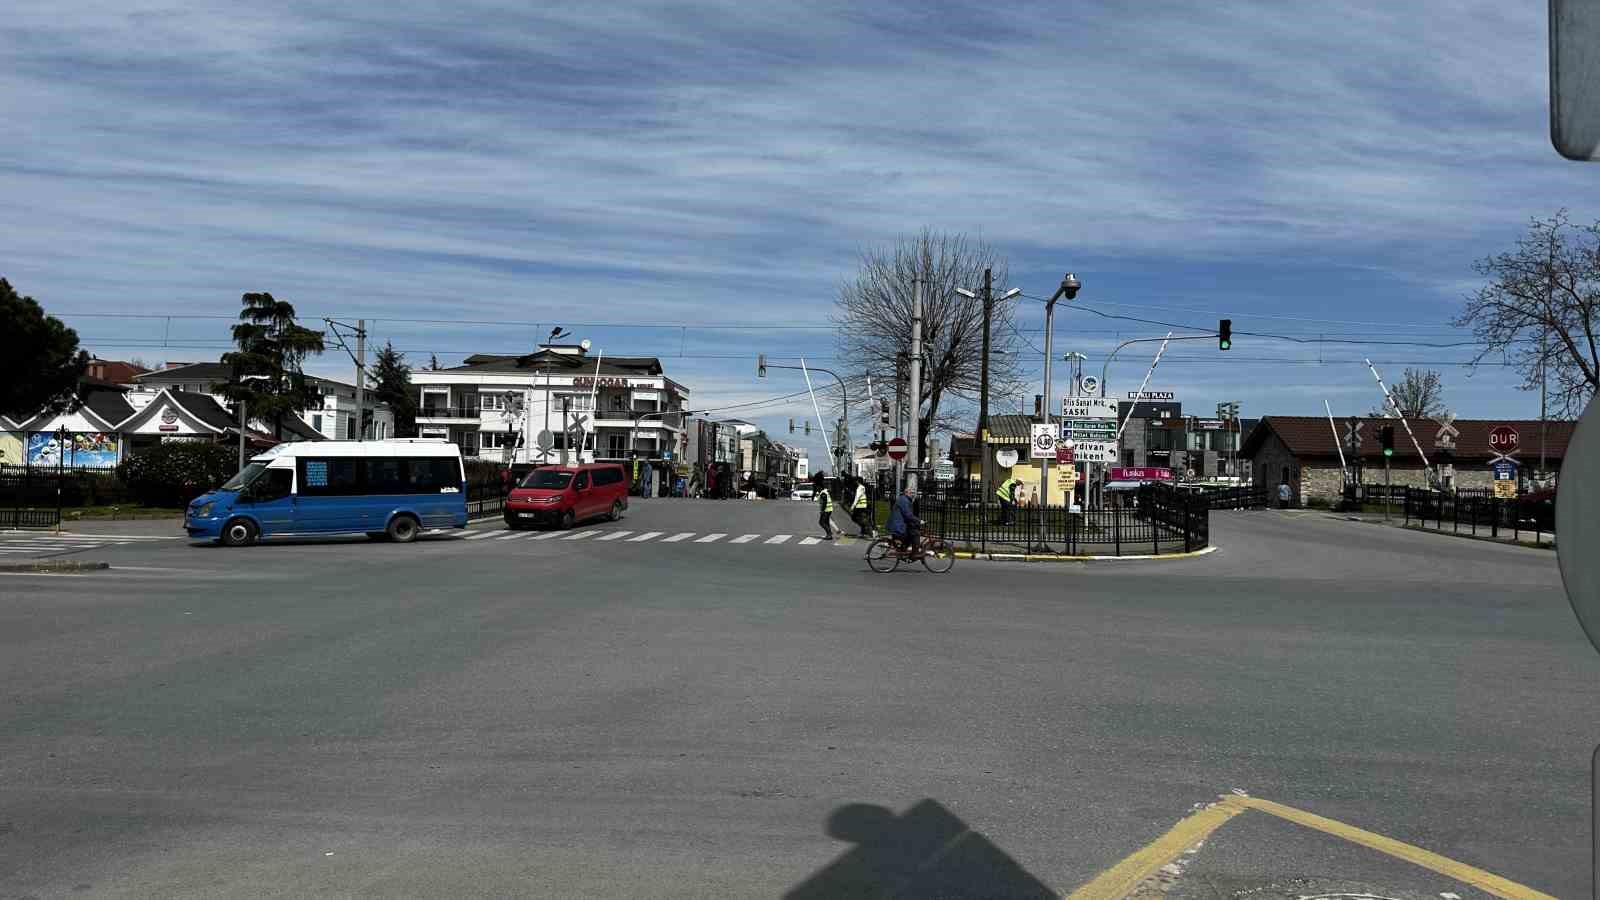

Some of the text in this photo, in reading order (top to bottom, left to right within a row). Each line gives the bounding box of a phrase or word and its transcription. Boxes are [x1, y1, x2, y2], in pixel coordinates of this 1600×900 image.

[1152, 391, 1174, 399] PLAZA
[1490, 433, 1517, 444] DUR
[1074, 442, 1104, 451] rdivan
[1074, 451, 1104, 460] nikent
